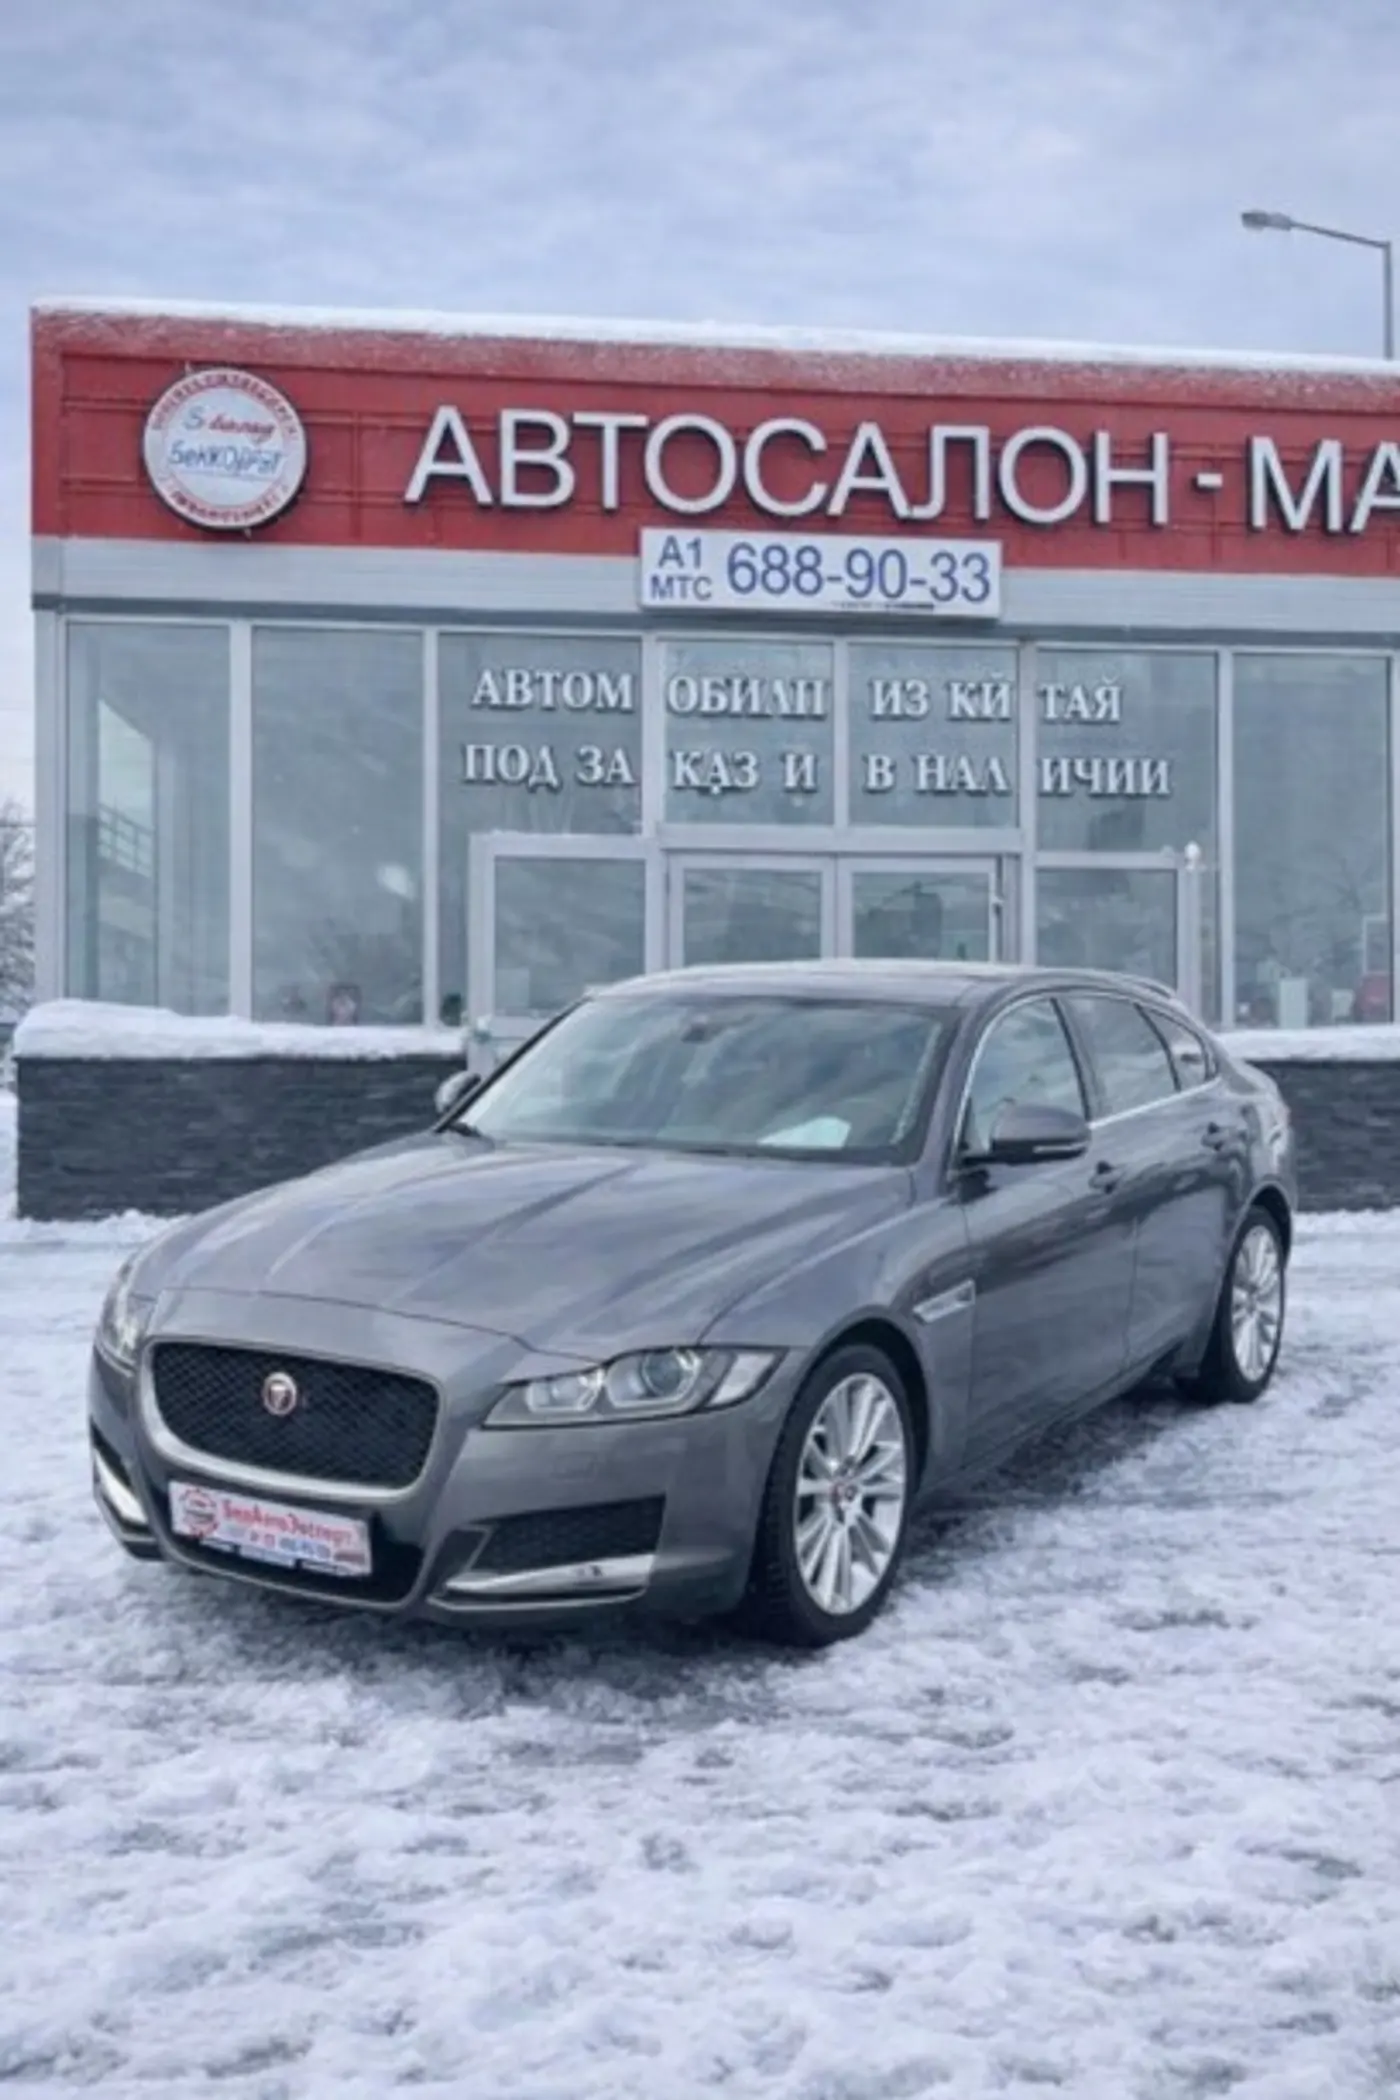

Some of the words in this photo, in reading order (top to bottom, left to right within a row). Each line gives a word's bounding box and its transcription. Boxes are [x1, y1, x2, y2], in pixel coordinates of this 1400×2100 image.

[403, 404, 1169, 525] АВТОСАЛОН
[1251, 435, 1400, 534] МА
[649, 575, 713, 601] МТС
[726, 541, 992, 603] 688-90-33
[470, 669, 635, 711] АВТОМ
[869, 678, 929, 719] ИЗ
[463, 744, 561, 792] ПОД
[575, 744, 637, 785] ЗА
[783, 753, 817, 792] И
[865, 754, 896, 792] В
[913, 754, 1012, 796] НАЛ
